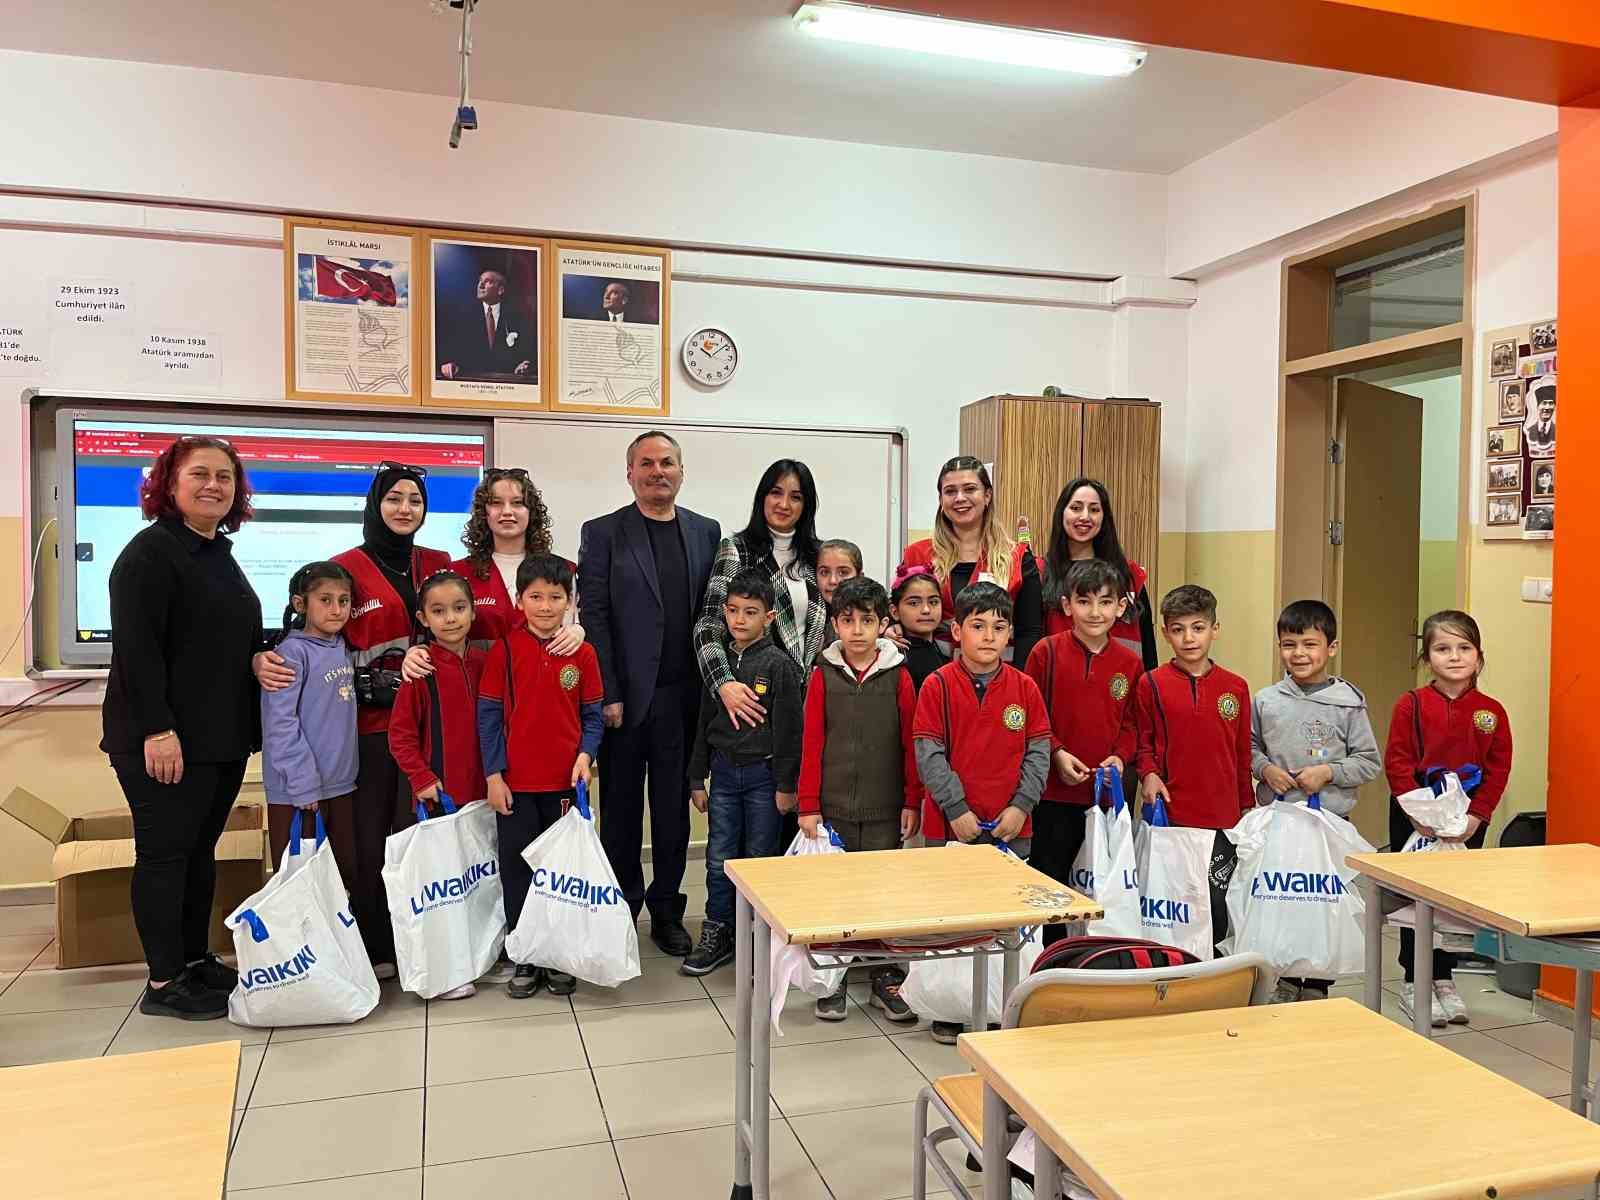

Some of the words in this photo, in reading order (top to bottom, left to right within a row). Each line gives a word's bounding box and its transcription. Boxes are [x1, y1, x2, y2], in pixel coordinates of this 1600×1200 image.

[60, 286, 72, 294] 29
[73, 286, 95, 294] Ekim
[98, 287, 120, 295] 1923
[55, 300, 107, 310] Cumhuriyet
[76, 314, 104, 323] edildi.
[150, 335, 161, 343] 10
[161, 337, 185, 345] Kasım
[187, 338, 207, 346] 1938
[13, 353, 41, 363] doğdu.
[141, 348, 171, 357] Atatürk
[173, 351, 215, 360] aramızdan
